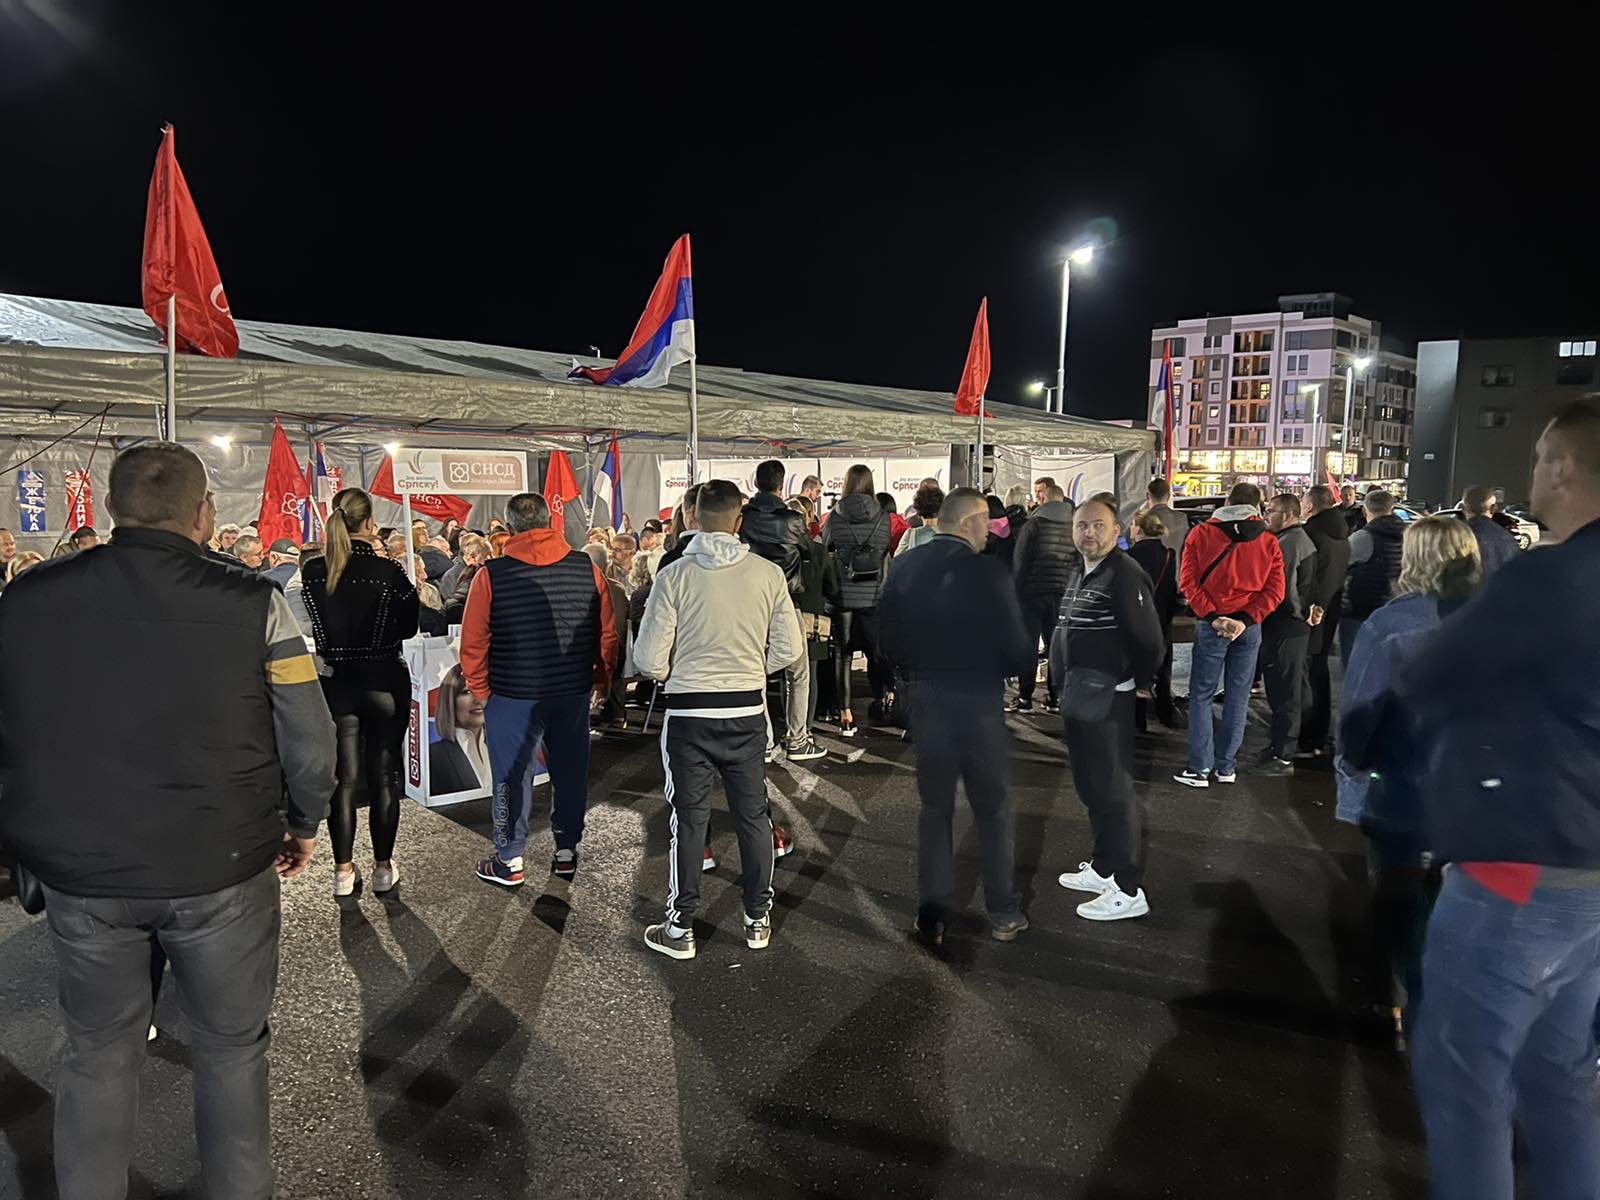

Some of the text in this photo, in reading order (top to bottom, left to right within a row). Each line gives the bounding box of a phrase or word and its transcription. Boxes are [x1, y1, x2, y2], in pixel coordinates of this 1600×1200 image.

[471, 462, 516, 479] СНСД
[398, 479, 439, 490] Српску!
[827, 479, 845, 490] Срп
[892, 481, 920, 491] Српск
[410, 494, 442, 509] НСД
[496, 782, 509, 848] adidas
